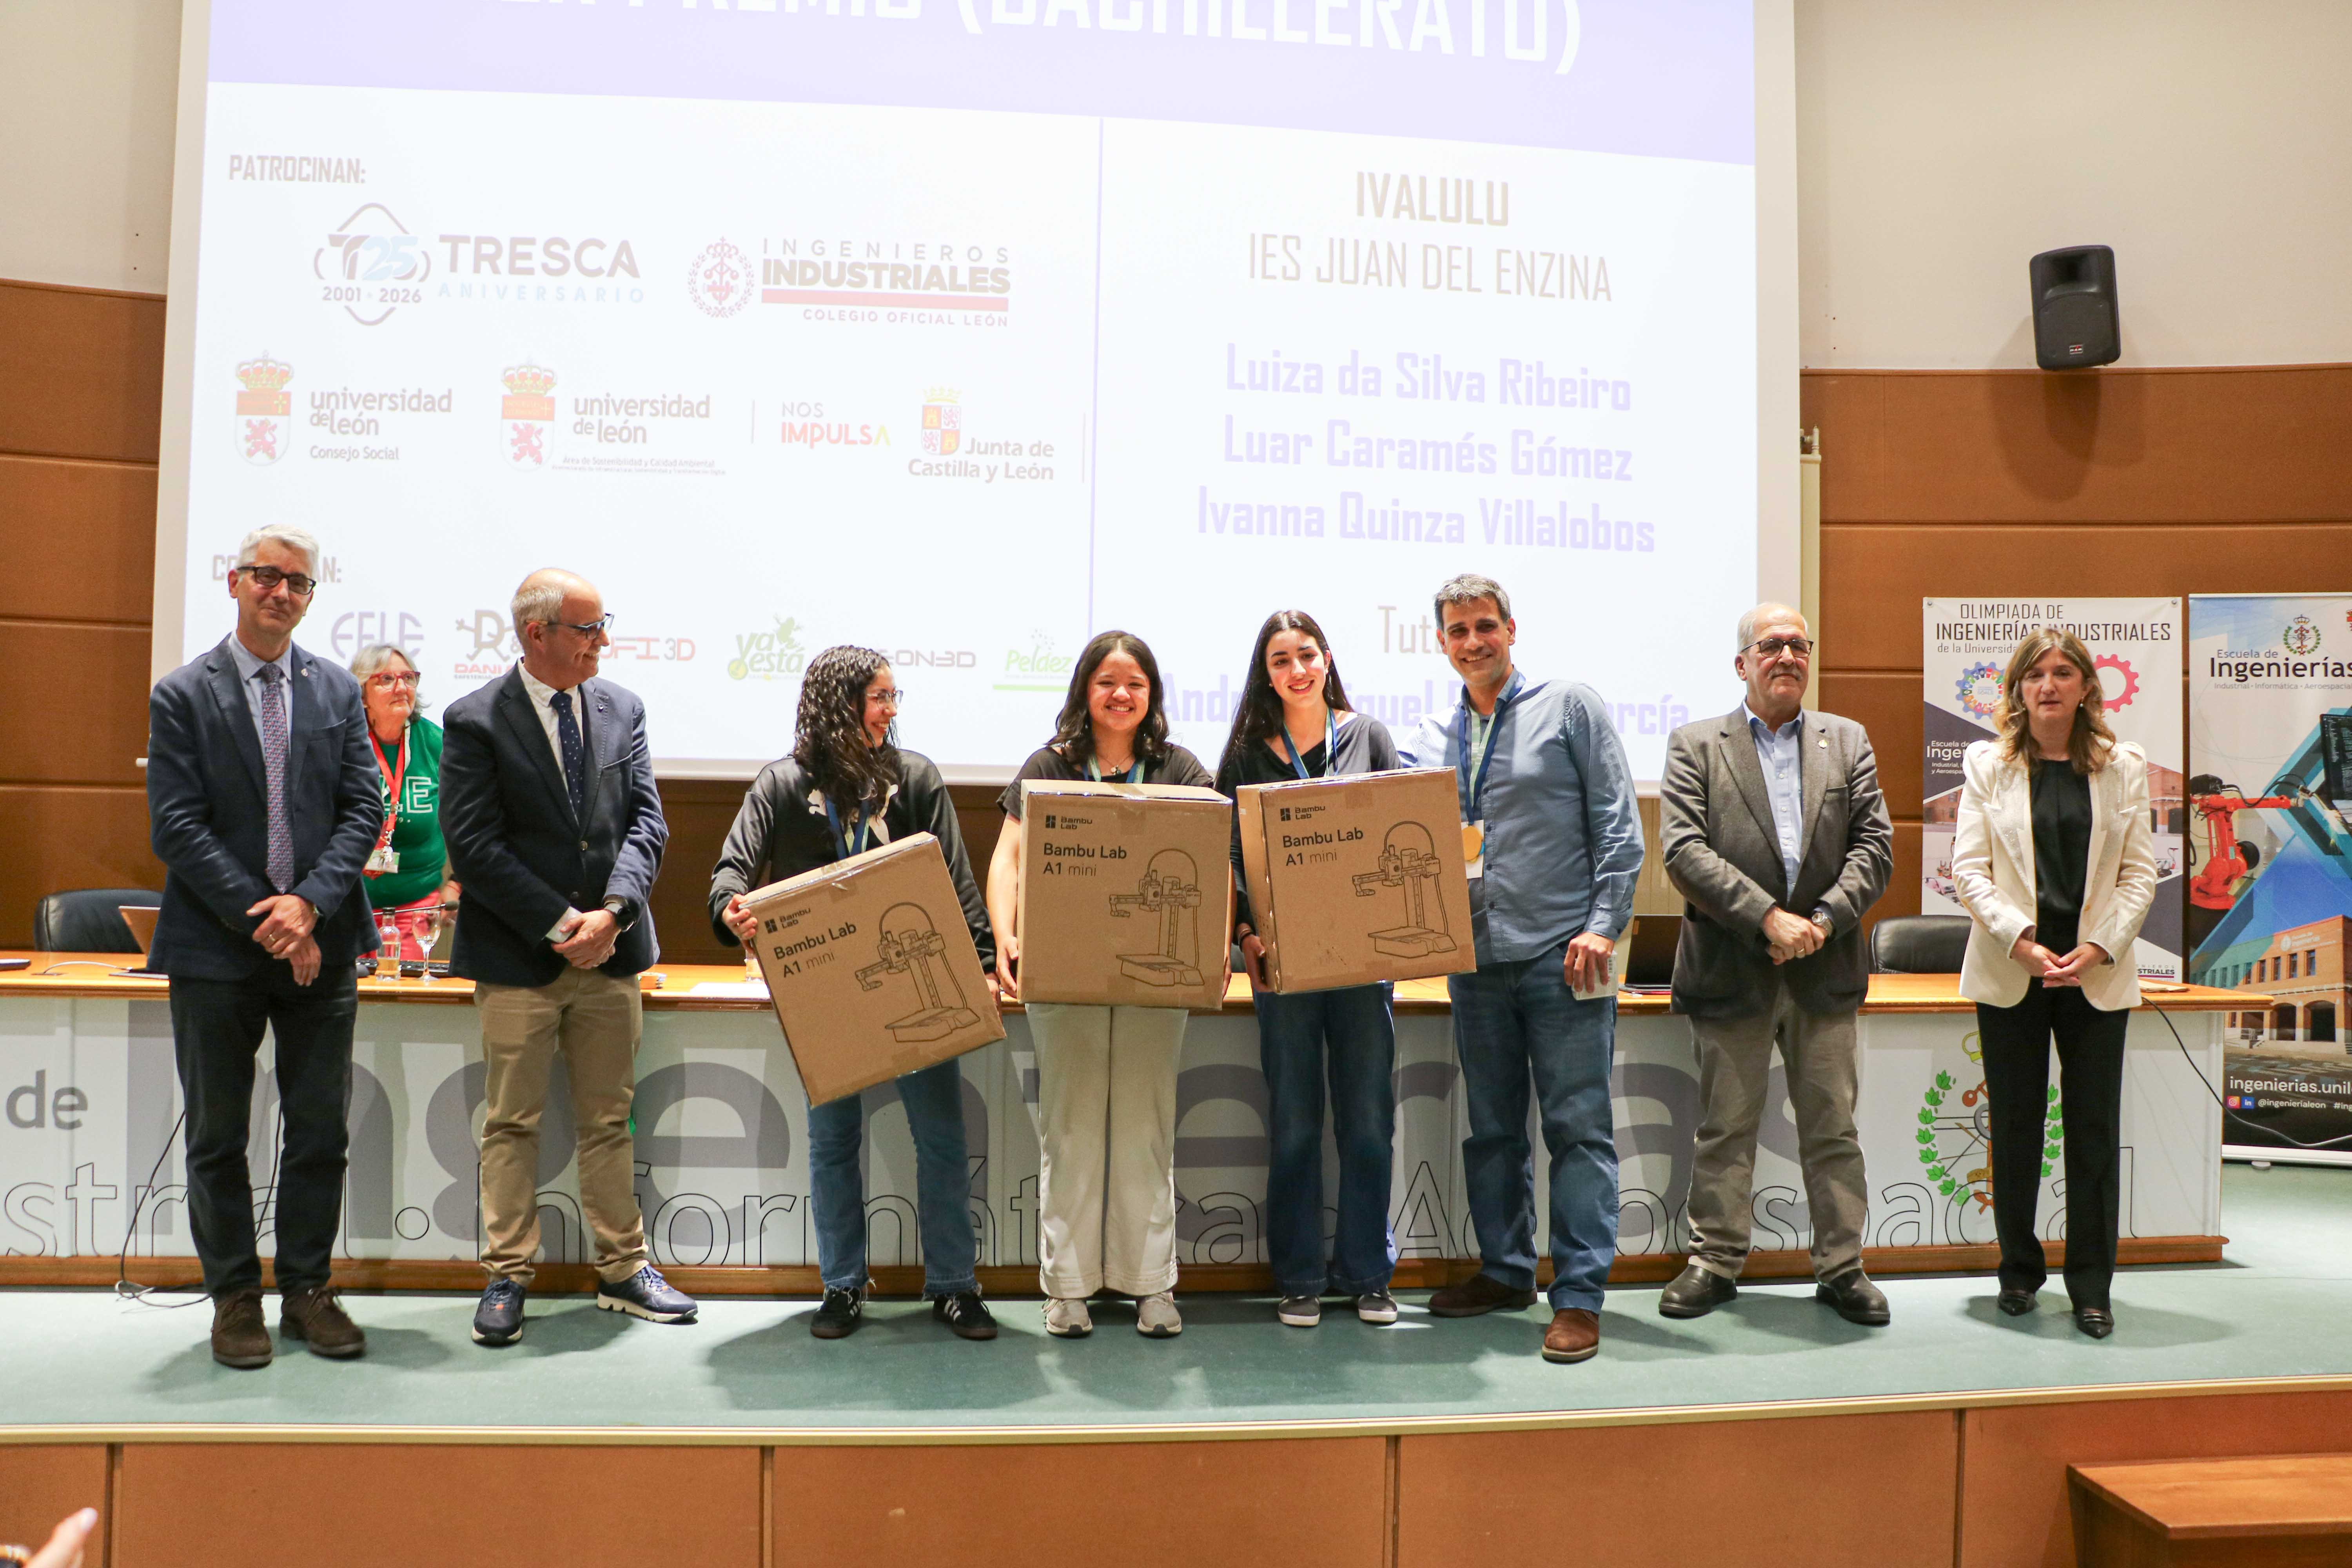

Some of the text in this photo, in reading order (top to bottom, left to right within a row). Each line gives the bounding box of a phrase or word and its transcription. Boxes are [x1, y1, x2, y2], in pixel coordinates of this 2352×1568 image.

[229, 154, 367, 183] PATROCINAN:
[1356, 171, 1509, 227] IVALULU
[439, 234, 641, 279] TRESCA
[763, 237, 1009, 264] INGENIEROS
[762, 258, 1011, 294] INDUSTRIALES
[1249, 233, 1612, 302] IES JUAN DEL ENZINA
[322, 286, 423, 304] 2001 2026
[437, 282, 645, 303] ANIVERSARIO
[803, 308, 1008, 328] COLEGIO OFICIAL LEÓN
[1226, 343, 1632, 412] Luiza da Silva Ribeiro
[310, 387, 453, 413] universidad
[573, 392, 711, 419] universidad
[782, 401, 824, 418] NOS
[309, 408, 379, 436] de león
[572, 418, 647, 444] de león
[310, 445, 400, 463] Consejo Social
[964, 436, 1054, 457] Junta de
[1223, 414, 1633, 482] Luar Caramés Gómez
[907, 458, 1054, 484] Castilla y León
[1198, 485, 1655, 553] Ivanna Quinza Villalobos
[1960, 604, 2064, 619] OLIMPIADA DE
[2049, 623, 2171, 641] DUSTRIALES
[1937, 643, 2018, 654] de la Universida
[2217, 649, 2278, 658] Escuela de
[1926, 746, 1965, 761] Inge
[1061, 816, 1093, 824] Bambu
[1283, 827, 1364, 848] Bambu Lab
[1044, 843, 1127, 859] Bambu Lab
[1286, 849, 1337, 866] A1 mini
[1043, 861, 1097, 877] A1 mini
[779, 907, 811, 923] Bambu
[782, 918, 799, 929] Lab
[773, 922, 857, 960] Bambu Lab
[784, 949, 835, 978] A1 mini
[2229, 1076, 2352, 1094] ingenierias.unil
[5, 1069, 88, 1130] de
[2258, 1099, 2327, 1109] @ingenierialeon
